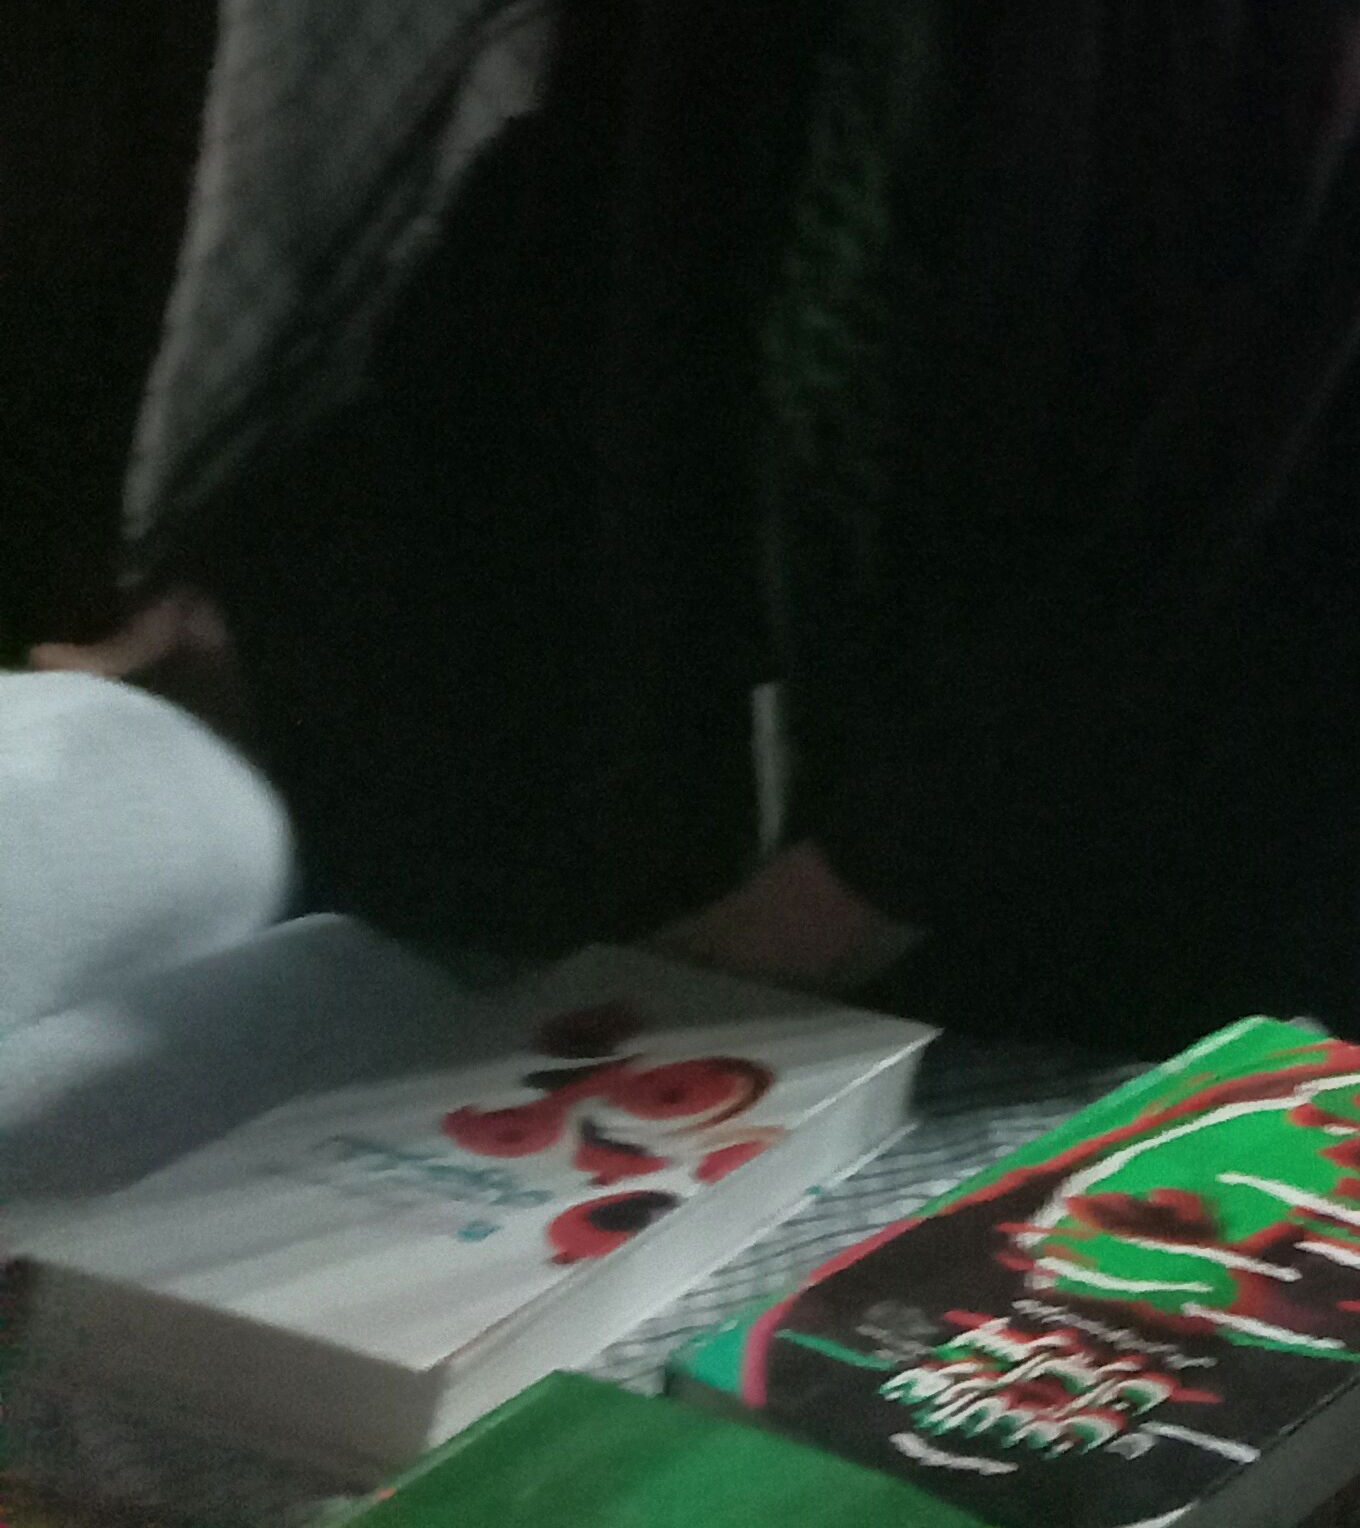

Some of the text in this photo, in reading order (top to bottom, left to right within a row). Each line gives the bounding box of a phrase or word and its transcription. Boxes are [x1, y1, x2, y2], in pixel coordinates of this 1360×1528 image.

[934, 1316, 1072, 1364] پسر
[878, 1363, 1119, 1459] نورالدین
[996, 1351, 1167, 1418] ایران
